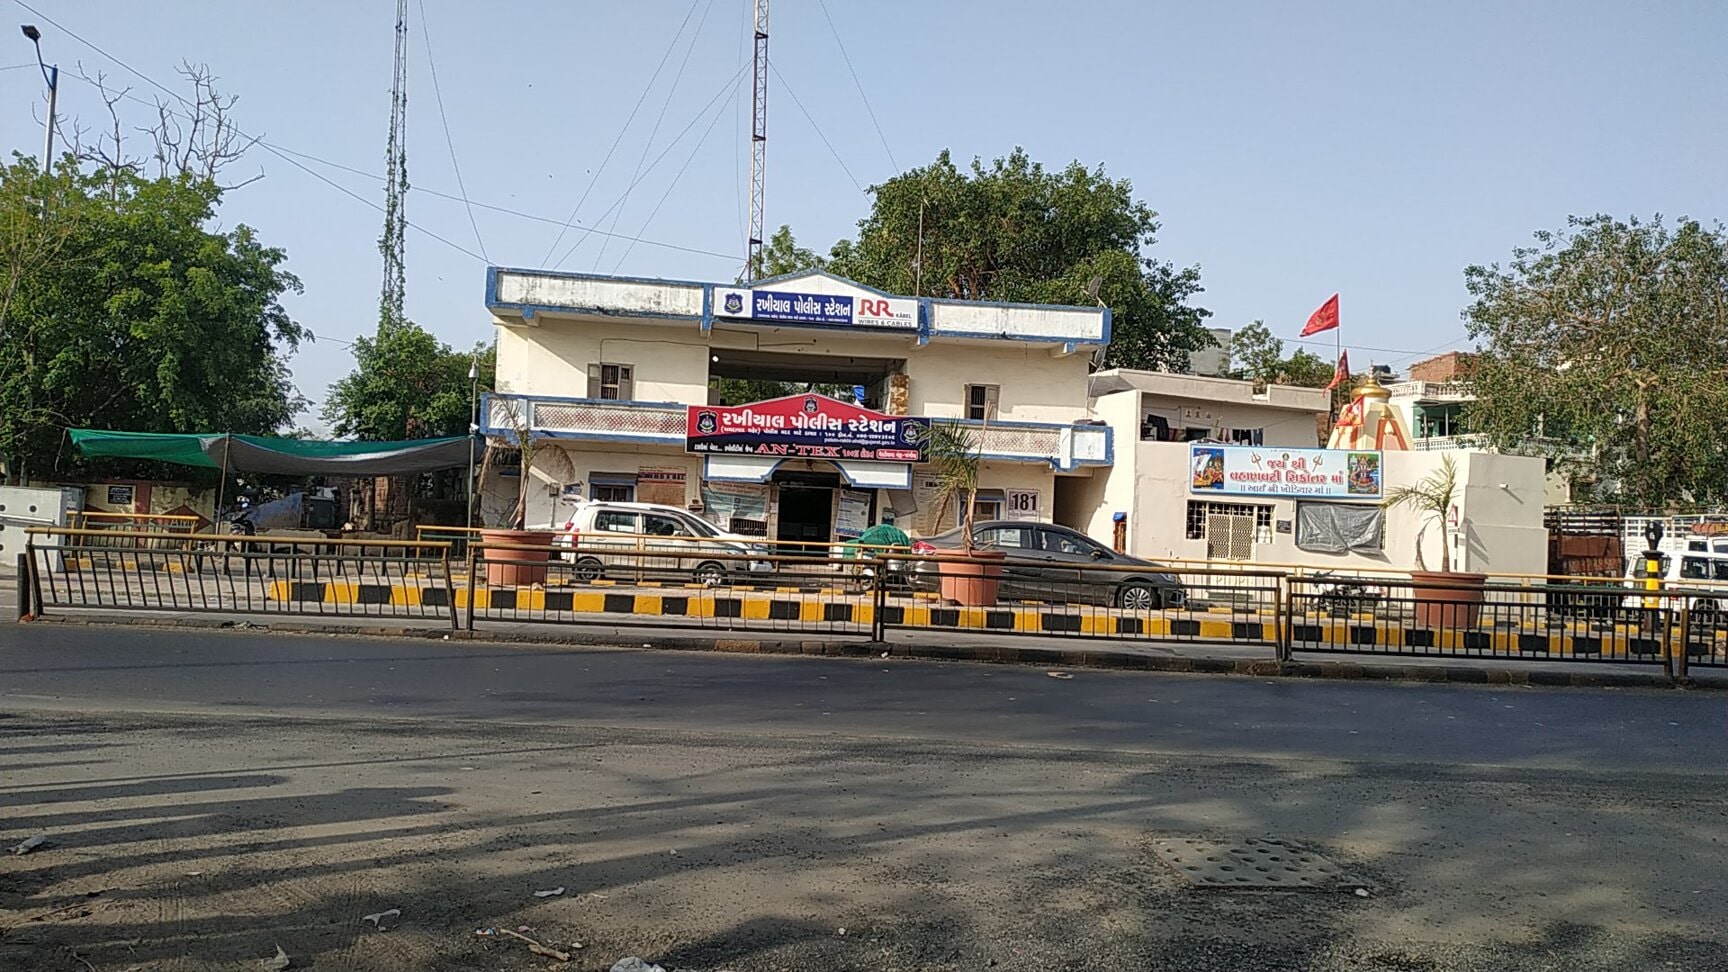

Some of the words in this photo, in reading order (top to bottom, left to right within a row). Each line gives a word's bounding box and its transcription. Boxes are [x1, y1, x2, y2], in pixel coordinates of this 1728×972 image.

[756, 294, 791, 313] રખીયાલ
[794, 295, 821, 315] પોલીસ
[824, 298, 851, 317] સ્ટેશન
[858, 299, 894, 317] RR
[722, 409, 785, 427] રખીયાલ
[790, 411, 842, 430] પોલીસ
[848, 415, 897, 433] સ્ટેશન
[754, 443, 841, 457] AN-TEX
[1267, 460, 1285, 469] જય
[1292, 457, 1307, 470] શ્રી
[1011, 493, 1037, 511] 181
